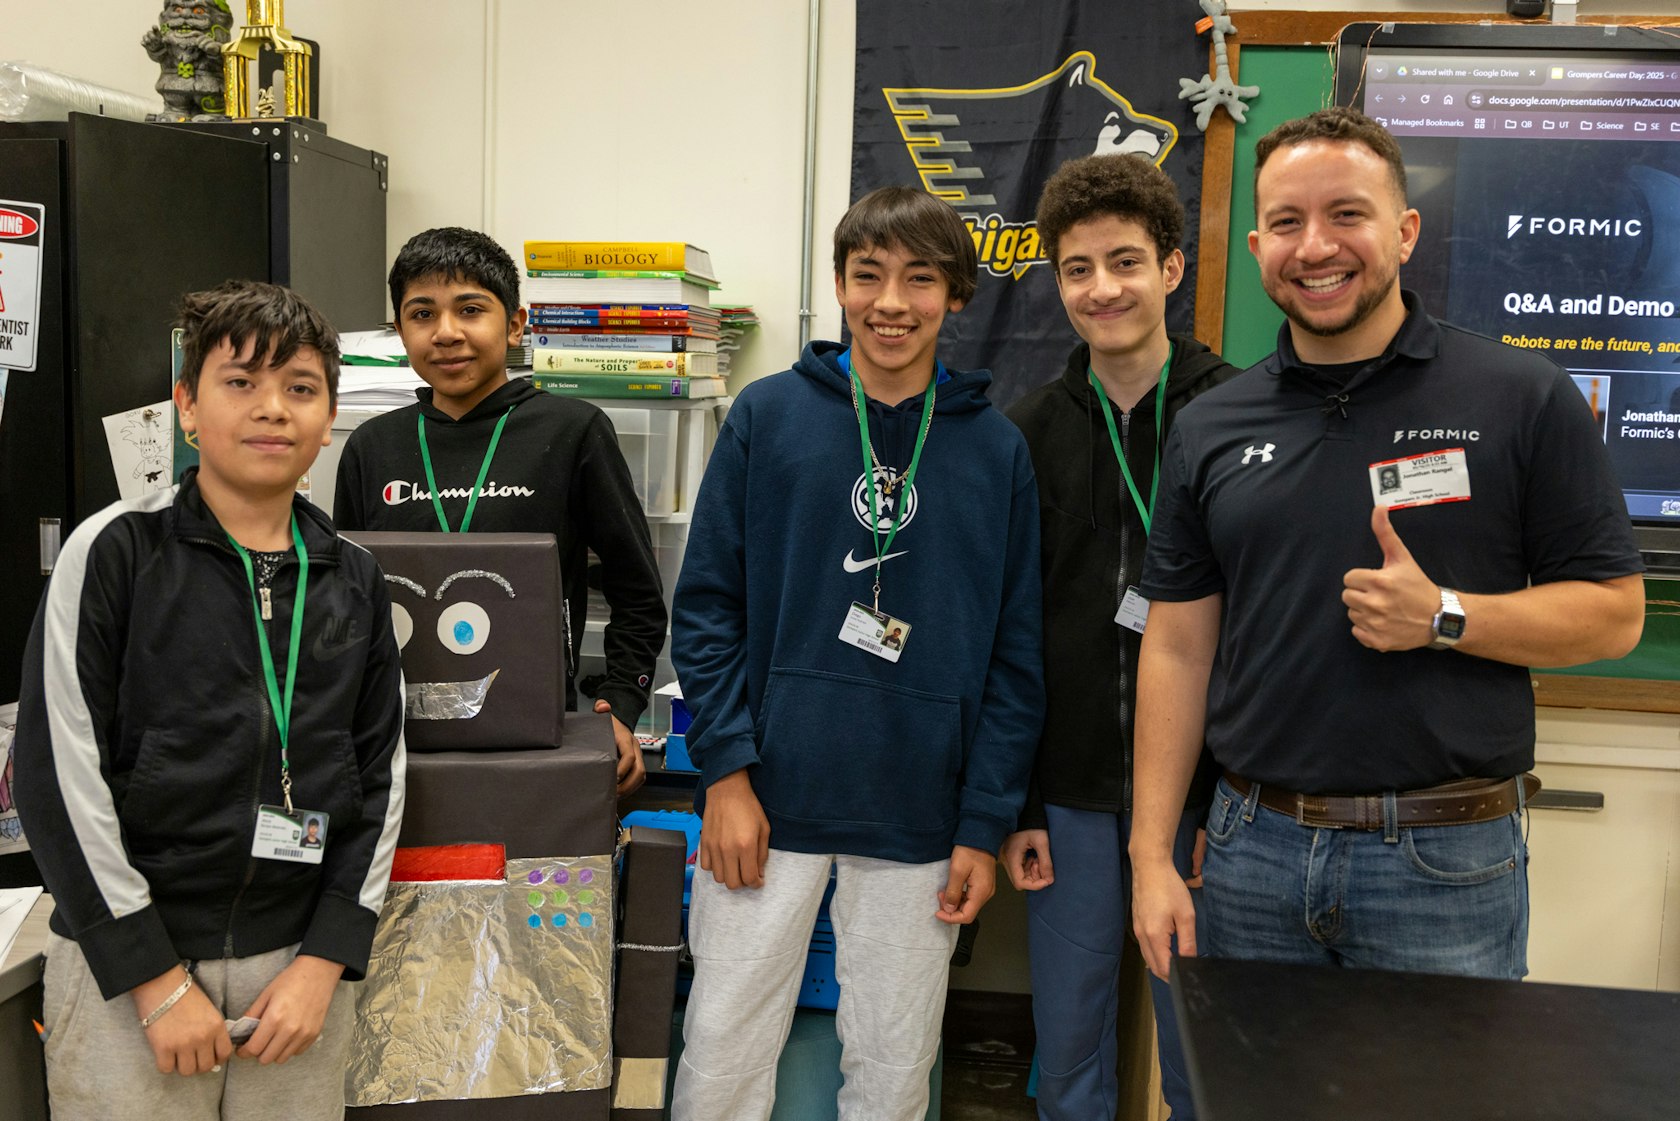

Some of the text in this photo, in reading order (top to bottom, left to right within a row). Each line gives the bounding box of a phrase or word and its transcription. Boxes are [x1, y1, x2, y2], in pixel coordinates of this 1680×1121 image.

[1412, 68, 1437, 76] Shared
[1438, 69, 1454, 77] with
[1473, 69, 1499, 78] Google
[1500, 70, 1519, 78] Drive
[1567, 70, 1601, 80] Grompers
[1604, 71, 1627, 79] Career
[1646, 72, 1664, 80] 2025
[1391, 118, 1464, 127] Managed Bookmarks
[1520, 120, 1532, 128] QB
[1559, 121, 1570, 129] UT
[1596, 121, 1624, 130] Science
[1650, 122, 1660, 131] SE
[1529, 217, 1642, 237] FORMIC
[584, 253, 658, 265] BIOLOGY
[1504, 292, 1675, 317] Q&A and Demo
[0, 318, 29, 336] NTIST
[611, 335, 637, 343] Studies
[1501, 335, 1550, 350] Robots
[1554, 339, 1577, 350] are
[1581, 337, 1604, 351] the
[1607, 337, 1653, 355] future,
[1408, 429, 1480, 441] FORMIC
[1411, 454, 1447, 466] VISITOR
